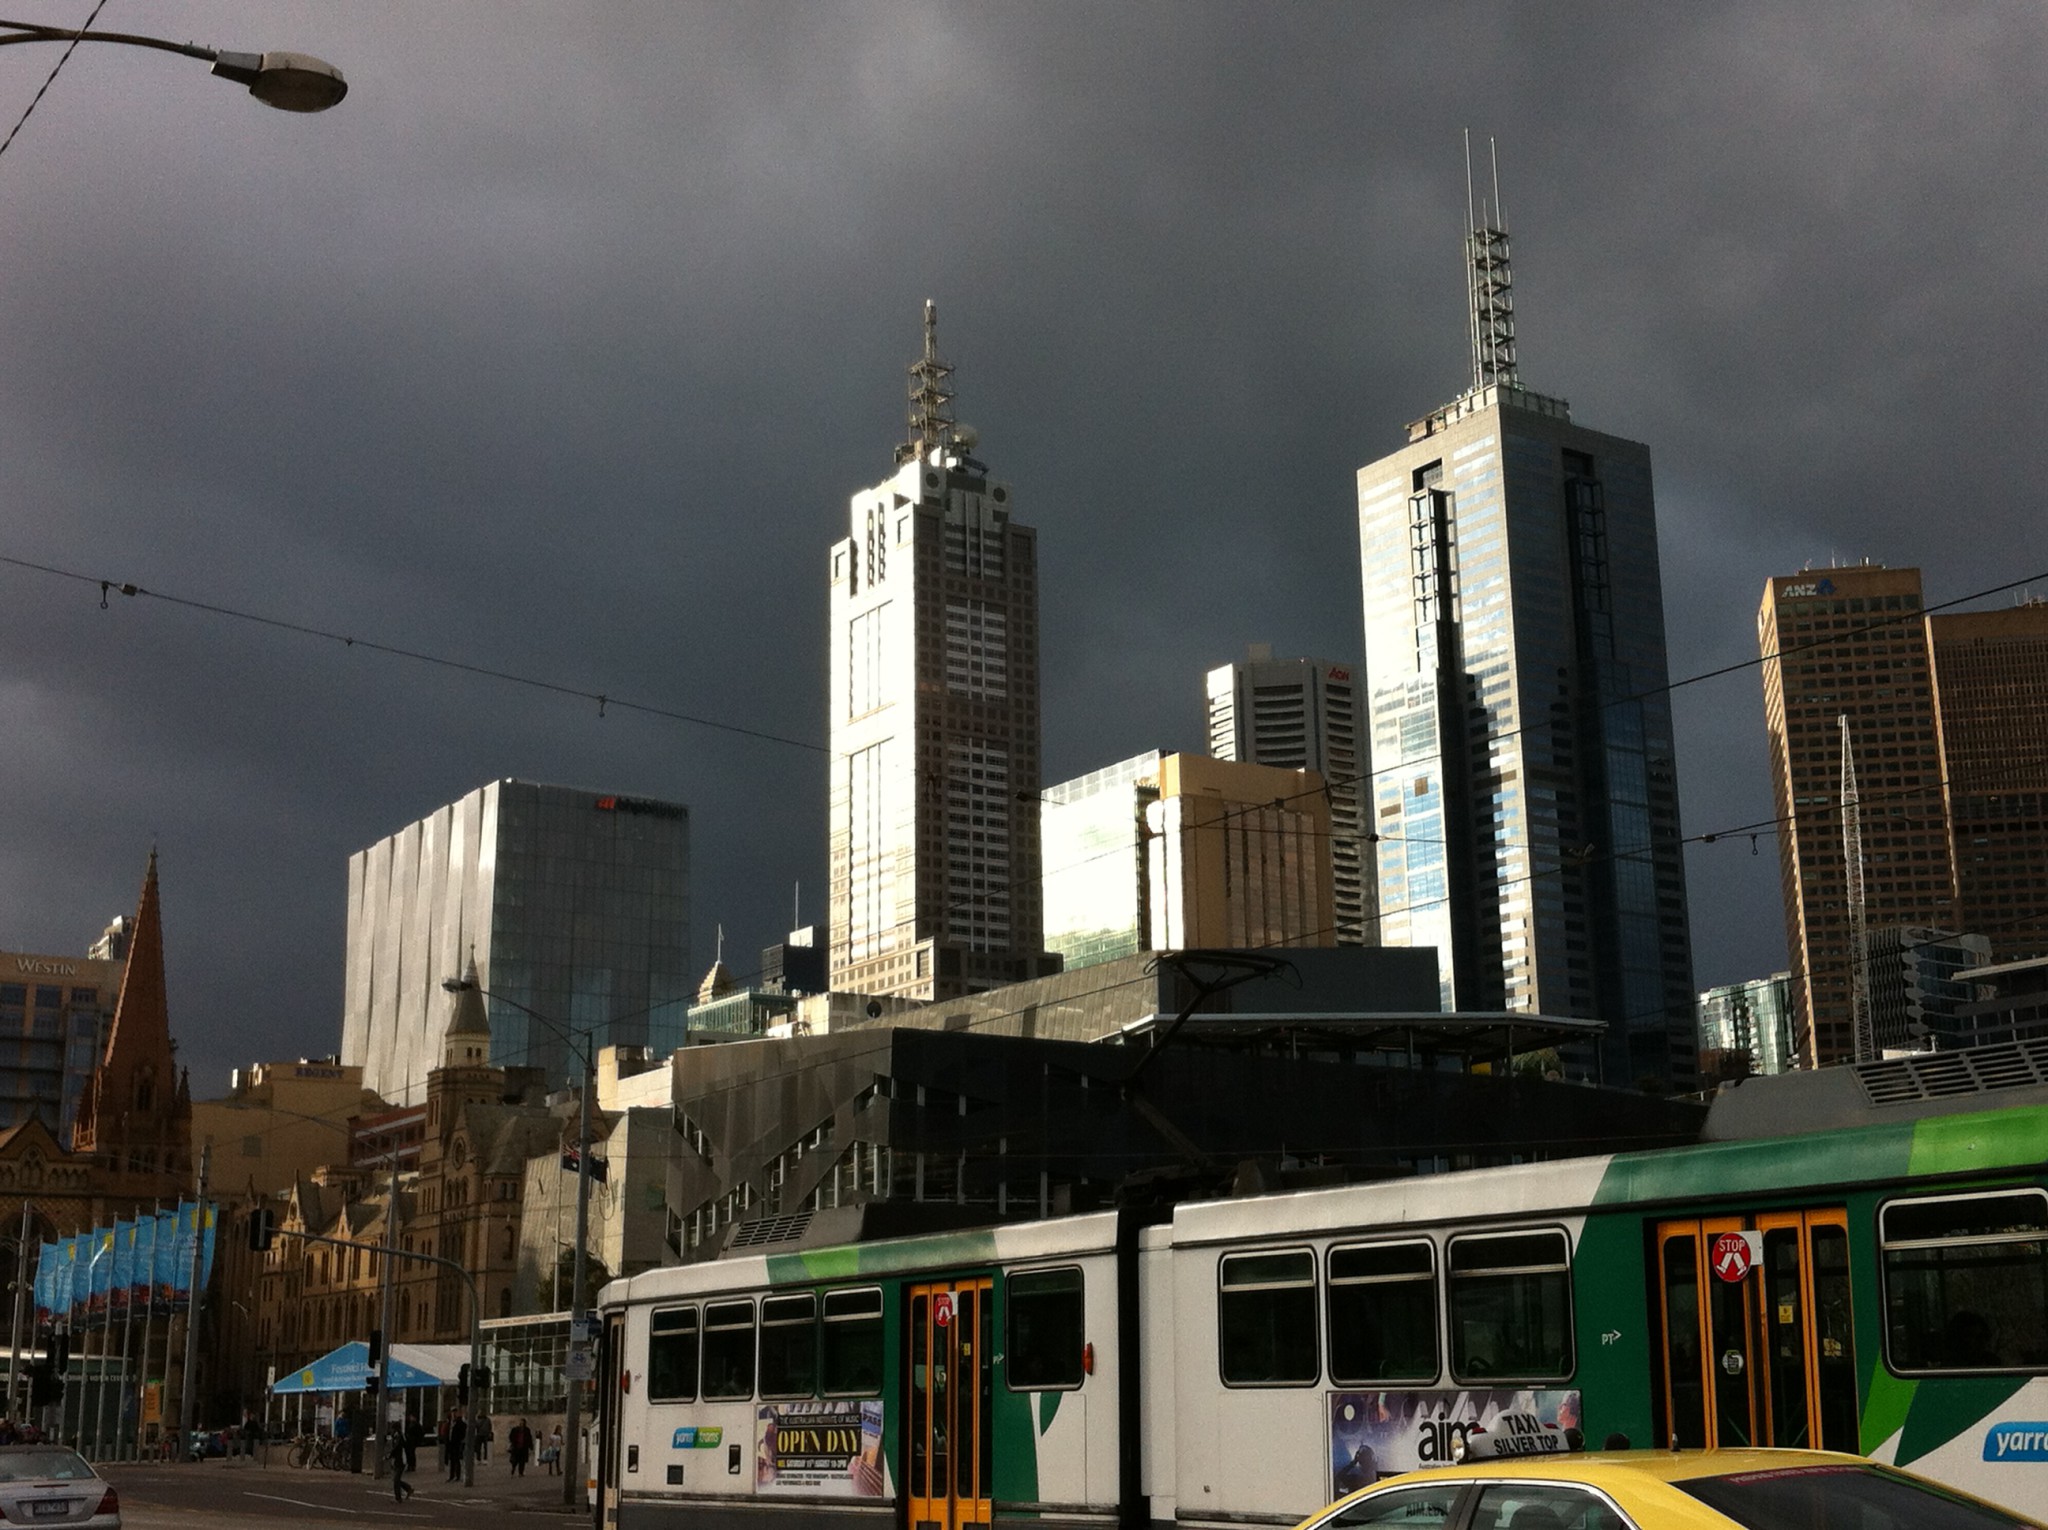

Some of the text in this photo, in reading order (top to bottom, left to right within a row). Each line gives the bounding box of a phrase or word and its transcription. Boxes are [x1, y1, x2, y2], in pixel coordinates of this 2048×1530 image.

[1781, 584, 1817, 598] ANZ
[294, 1066, 345, 1079] REGENT
[1719, 1238, 1746, 1252] STOP
[1502, 1414, 1541, 1437] TAXI
[778, 1429, 858, 1453] OPEN DAY
[1494, 1433, 1560, 1455] SILVER TOP
